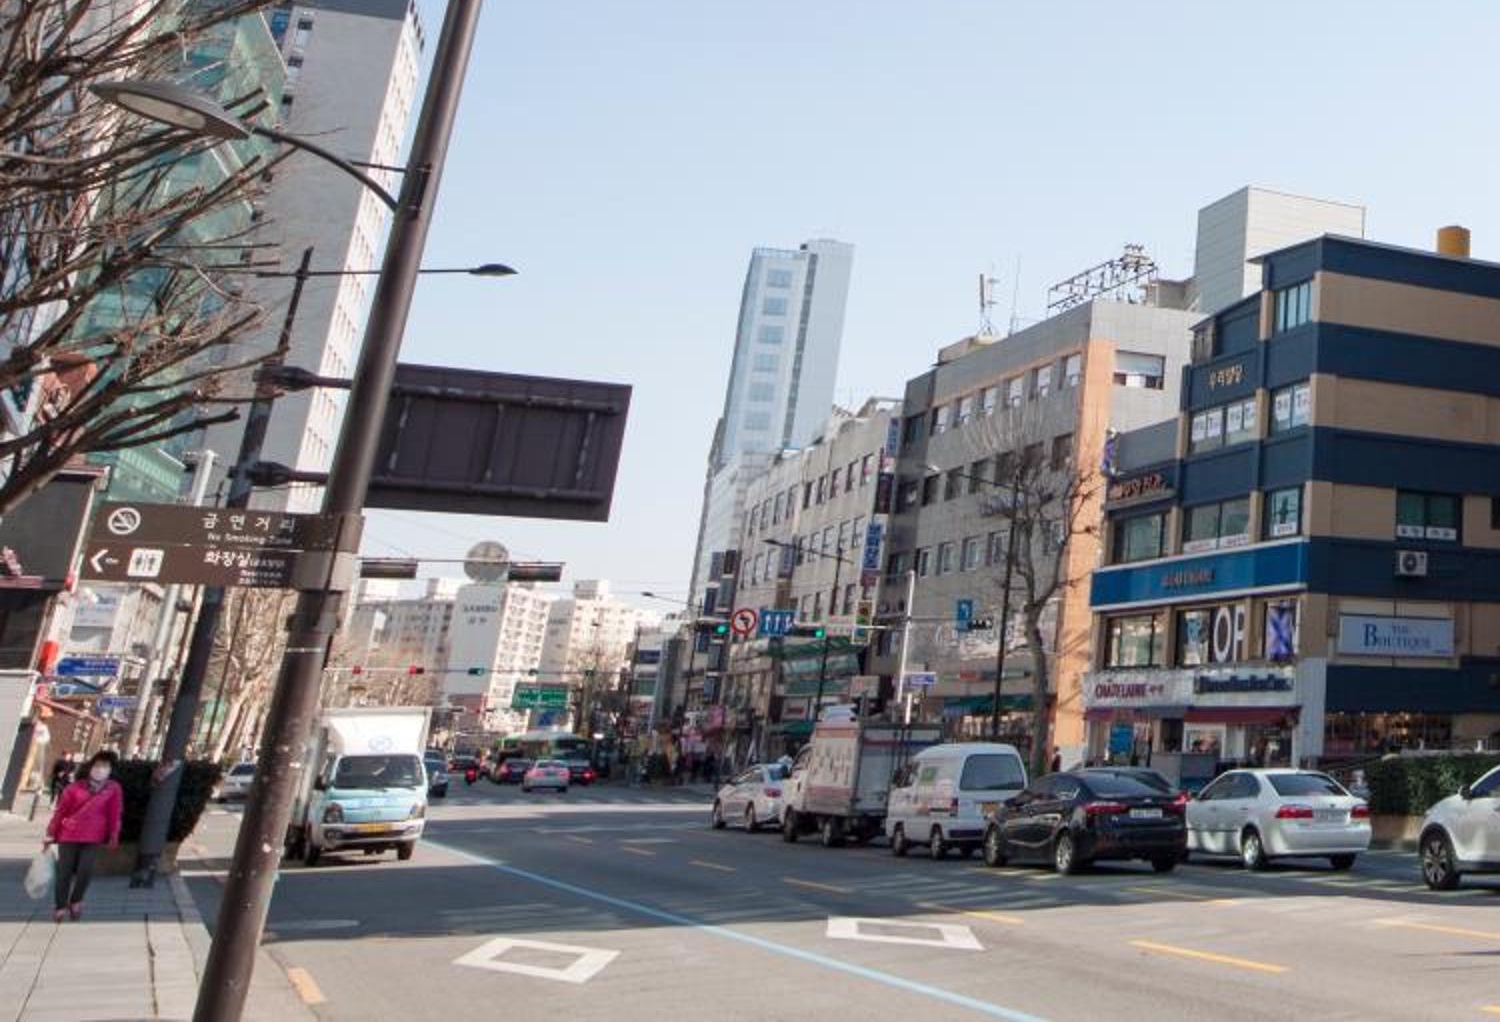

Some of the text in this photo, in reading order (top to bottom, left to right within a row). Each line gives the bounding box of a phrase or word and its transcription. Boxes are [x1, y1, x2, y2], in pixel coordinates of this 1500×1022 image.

[203, 513, 296, 533] 금연거리
[207, 533, 221, 541] No
[224, 533, 266, 545] Smoking
[203, 551, 252, 568] 화장실
